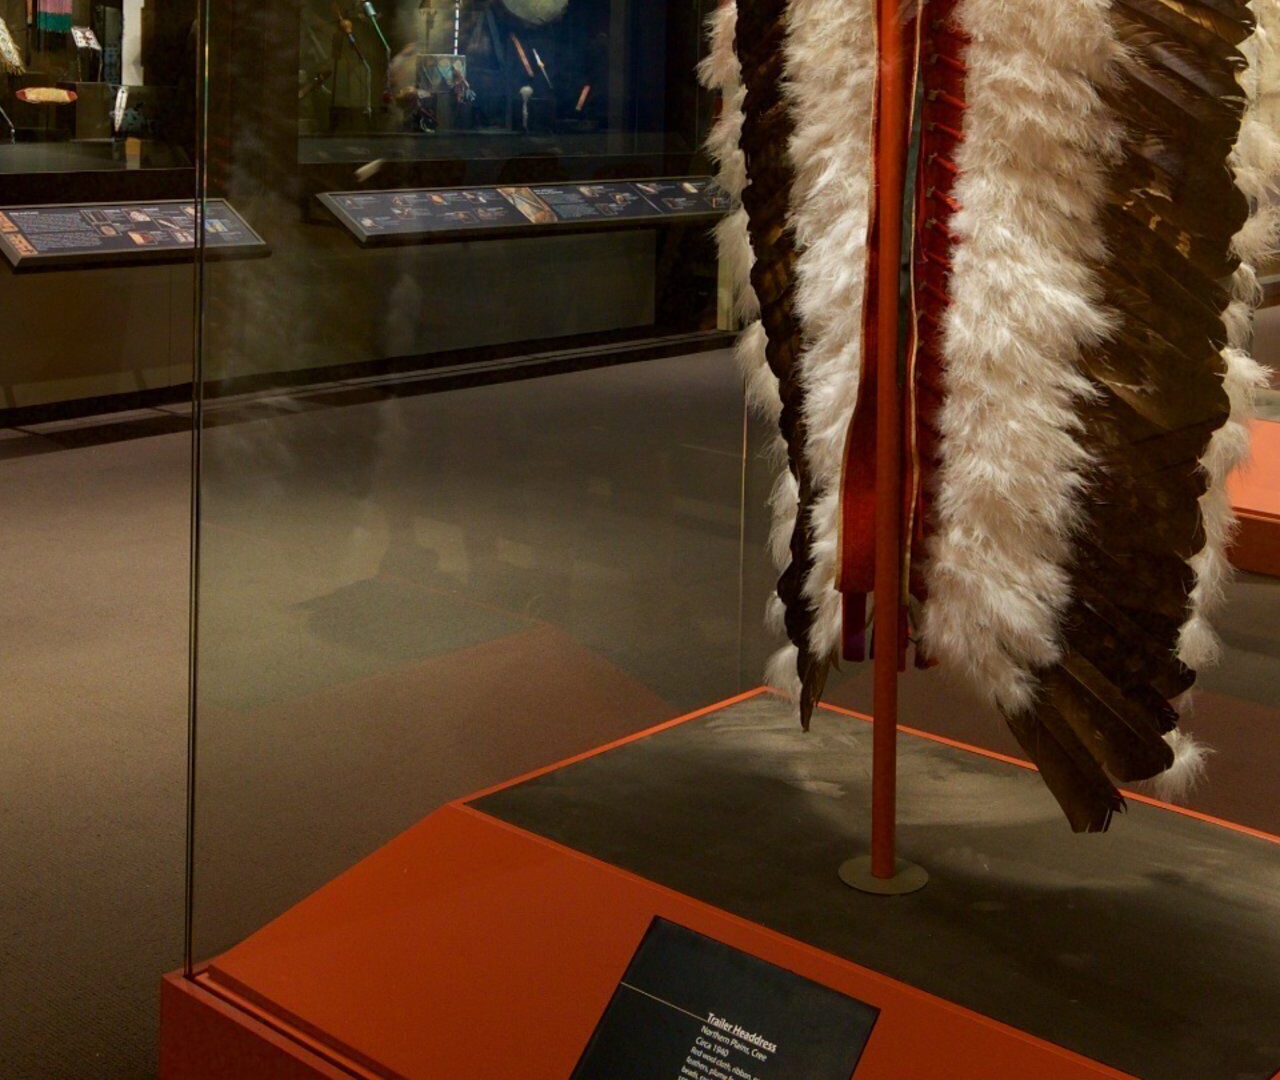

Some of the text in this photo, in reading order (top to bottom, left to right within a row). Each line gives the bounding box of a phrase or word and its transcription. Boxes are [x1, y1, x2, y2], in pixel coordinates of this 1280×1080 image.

[695, 1036, 712, 1050] Circa
[701, 1025, 768, 1062] Northern Plains, Cree
[707, 1012, 777, 1053] Trailer Headdress
[690, 1046, 704, 1057] Red
